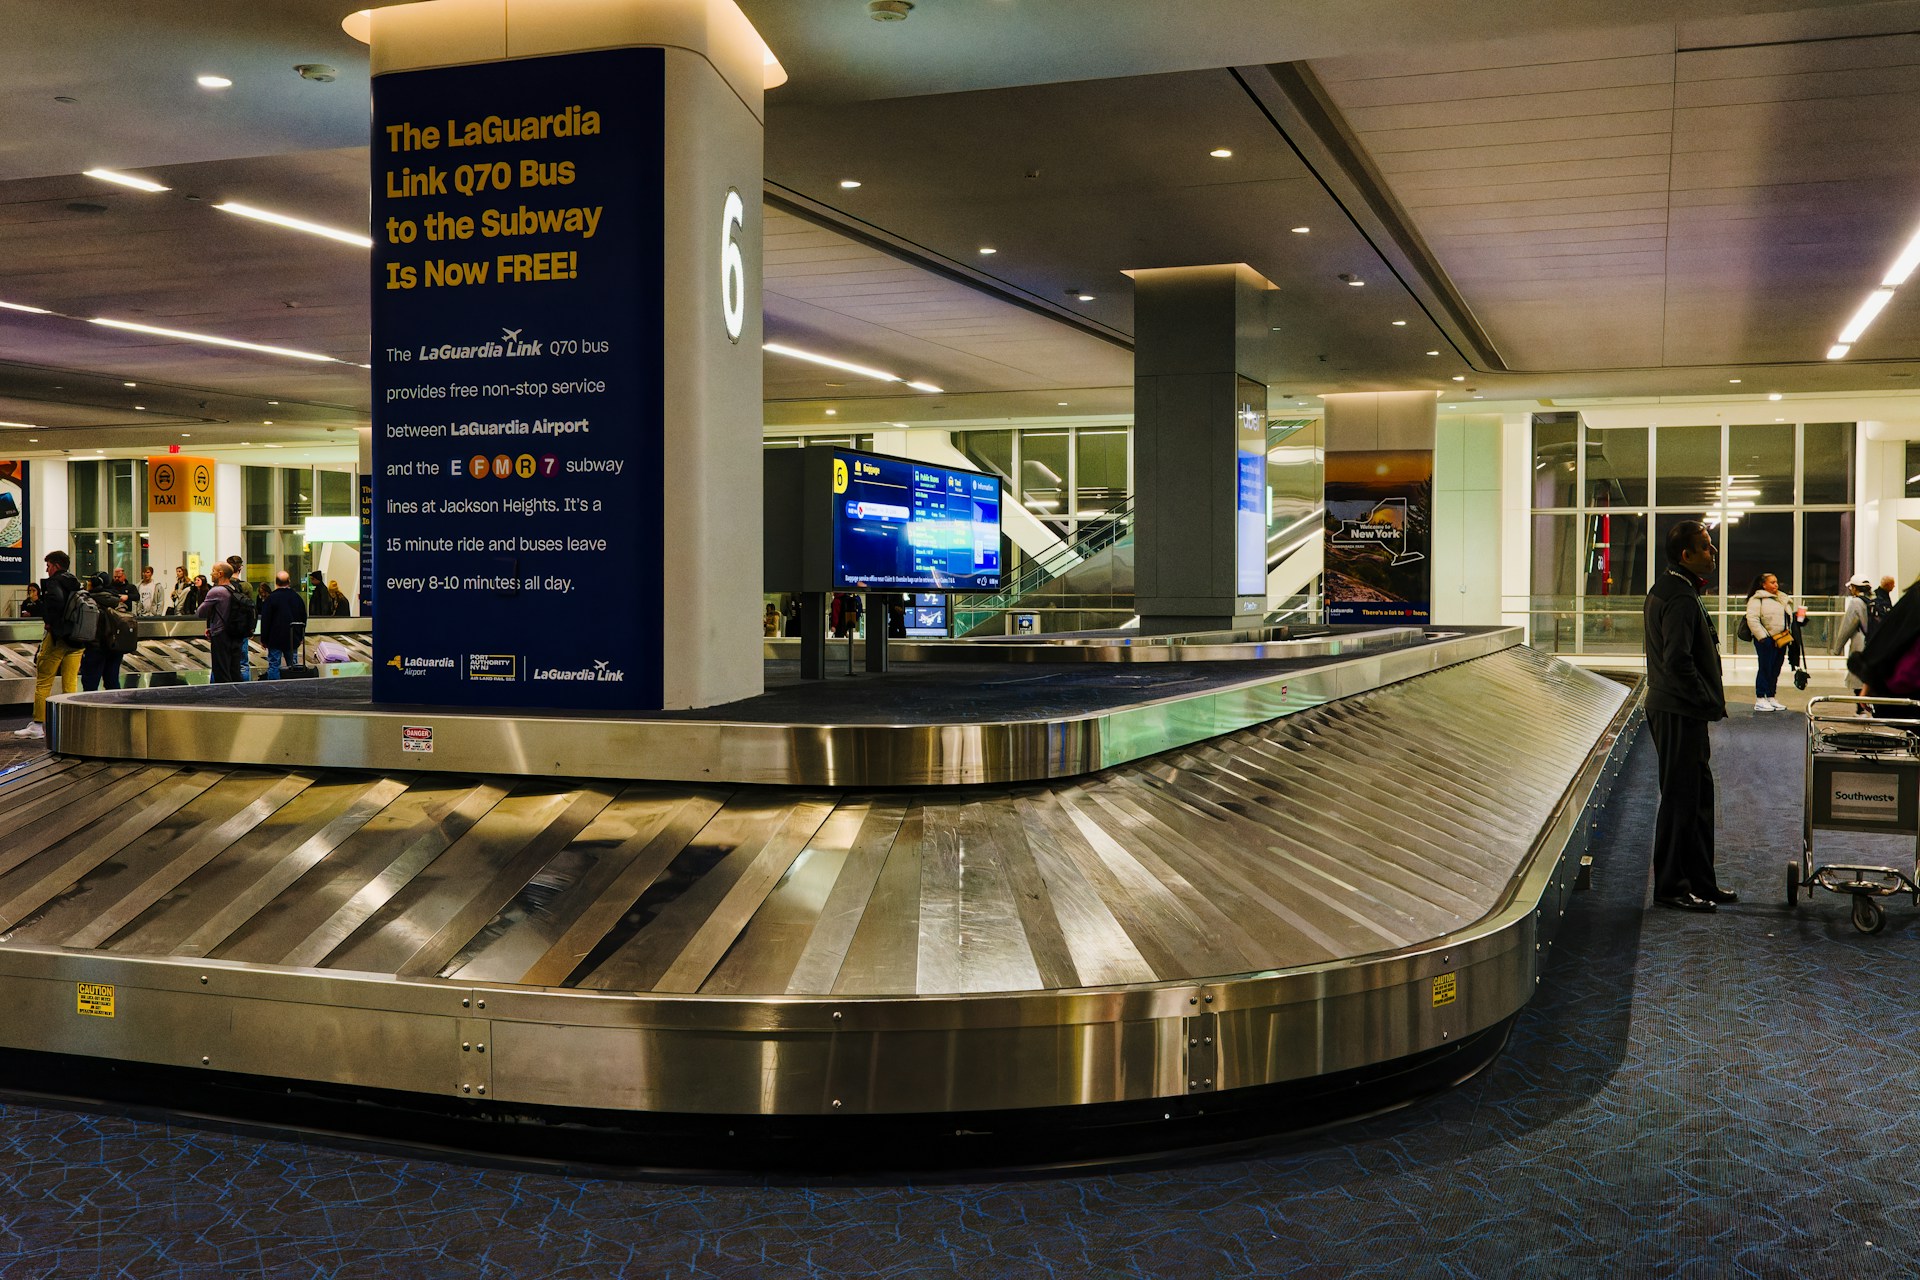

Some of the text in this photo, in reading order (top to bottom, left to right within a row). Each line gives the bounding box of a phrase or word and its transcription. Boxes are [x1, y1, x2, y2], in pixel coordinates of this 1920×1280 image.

[386, 104, 601, 152] The LaGuardia
[386, 159, 576, 199] Link Q70 Bus
[385, 205, 603, 244] to the Subway
[386, 250, 578, 290] Is Now FREE!
[721, 186, 745, 344] 6
[386, 338, 609, 362] The LaGuardia Link Q70 bus
[386, 377, 606, 404] provides free non-stop service
[1242, 402, 1260, 432] Uber
[386, 418, 589, 438] between LaGuardia Airport
[386, 457, 624, 476] and the E F M R 7 subway
[837, 467, 843, 486] 6
[154, 495, 176, 505] TAXI
[193, 495, 211, 506] TAXI
[386, 497, 601, 517] lines at Jackson Heights. It's a
[1351, 529, 1400, 538] New York
[386, 536, 607, 552] 15 minute ride and buses leave
[386, 574, 575, 594] every 8-10 minutes all day.
[405, 657, 454, 667] LaGuardia
[404, 668, 426, 676] Airport
[533, 668, 625, 683] LaGuardia Link
[1835, 791, 1888, 802] Southwest
[79, 984, 113, 997] CAUTION
